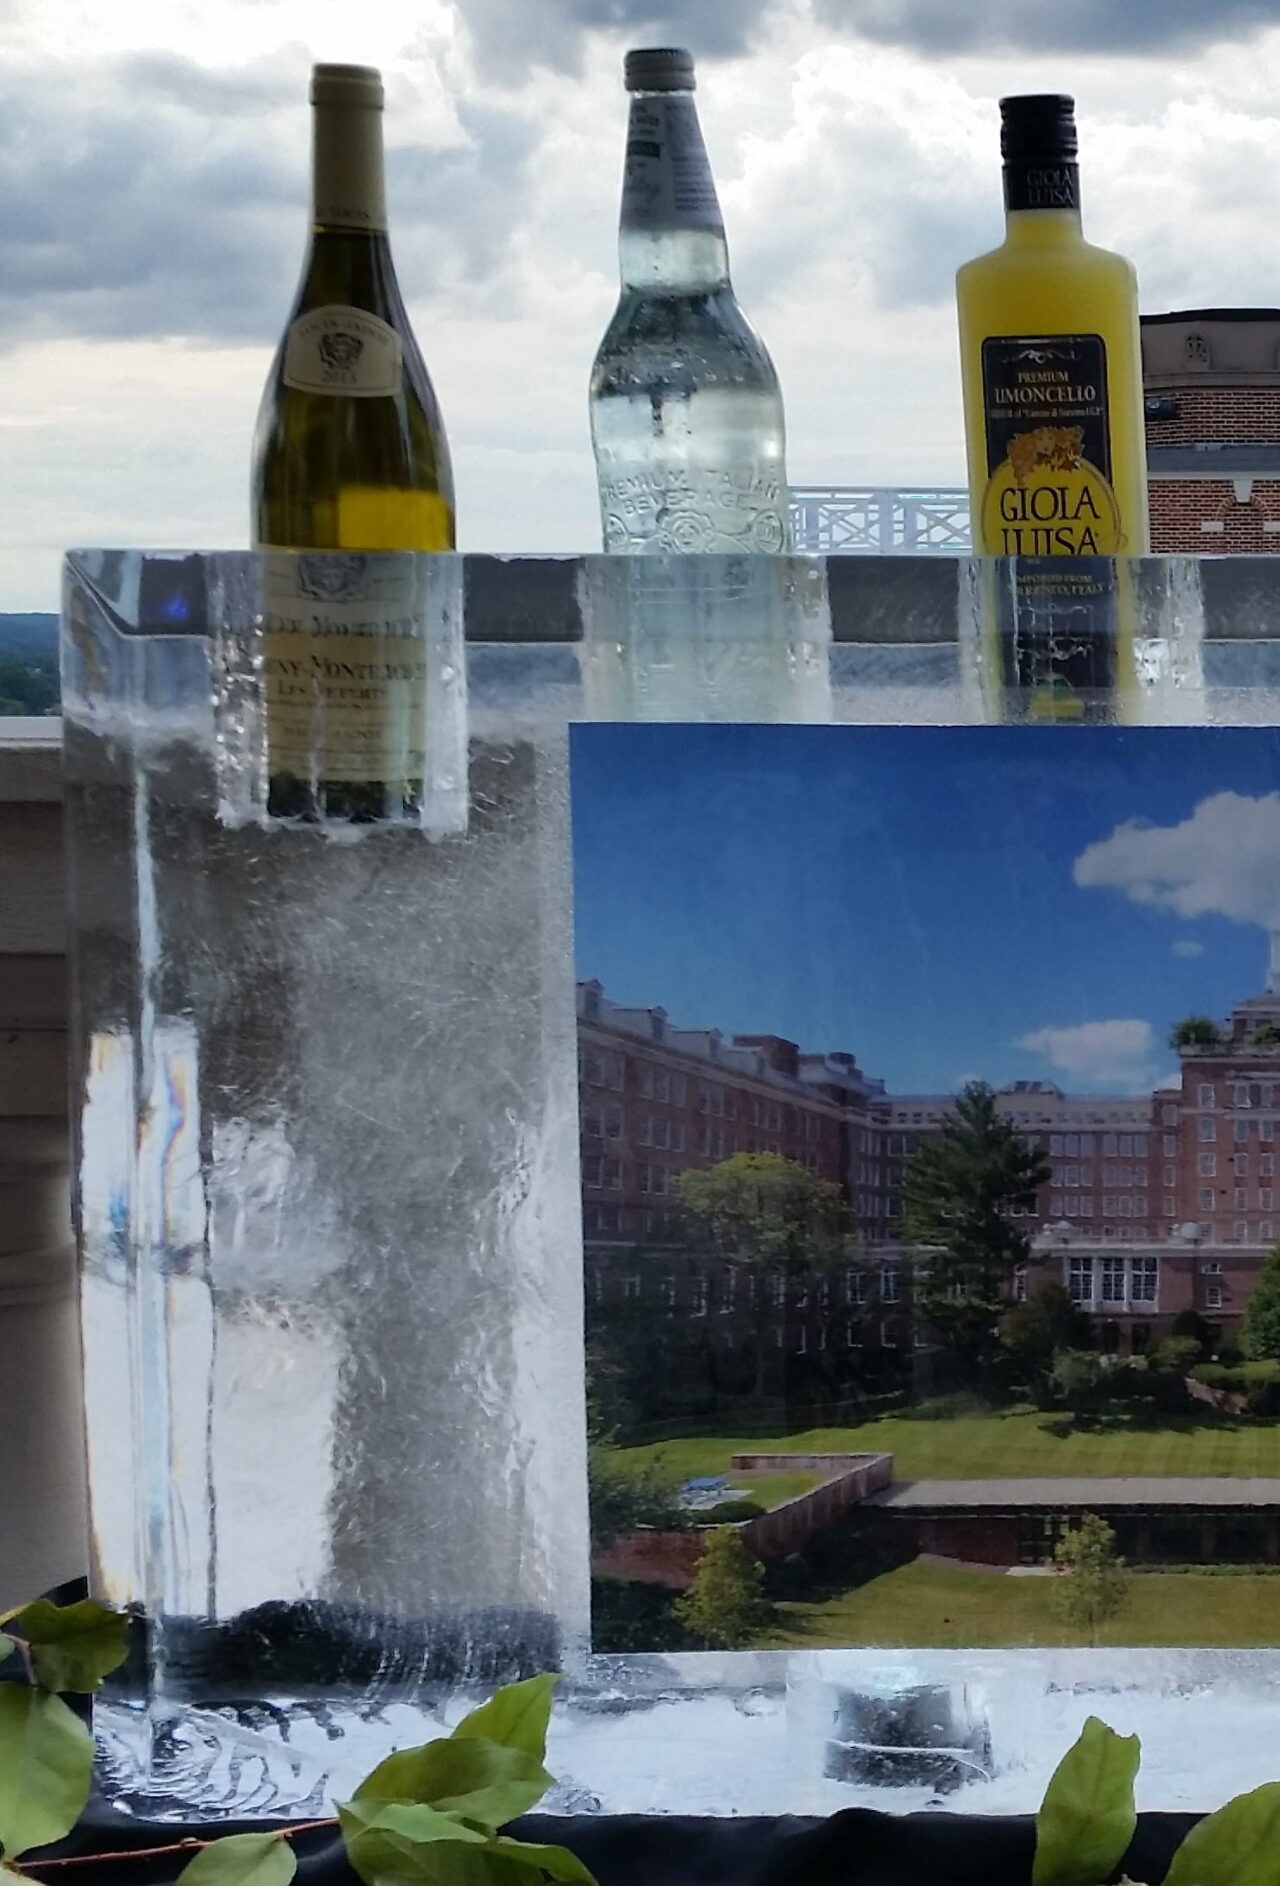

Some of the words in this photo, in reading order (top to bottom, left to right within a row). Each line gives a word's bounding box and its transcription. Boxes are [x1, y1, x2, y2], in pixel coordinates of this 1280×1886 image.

[1018, 371, 1069, 384] PREMIUM
[994, 384, 1097, 404] LIMONCELLO
[1000, 485, 1101, 522] GIOIA
